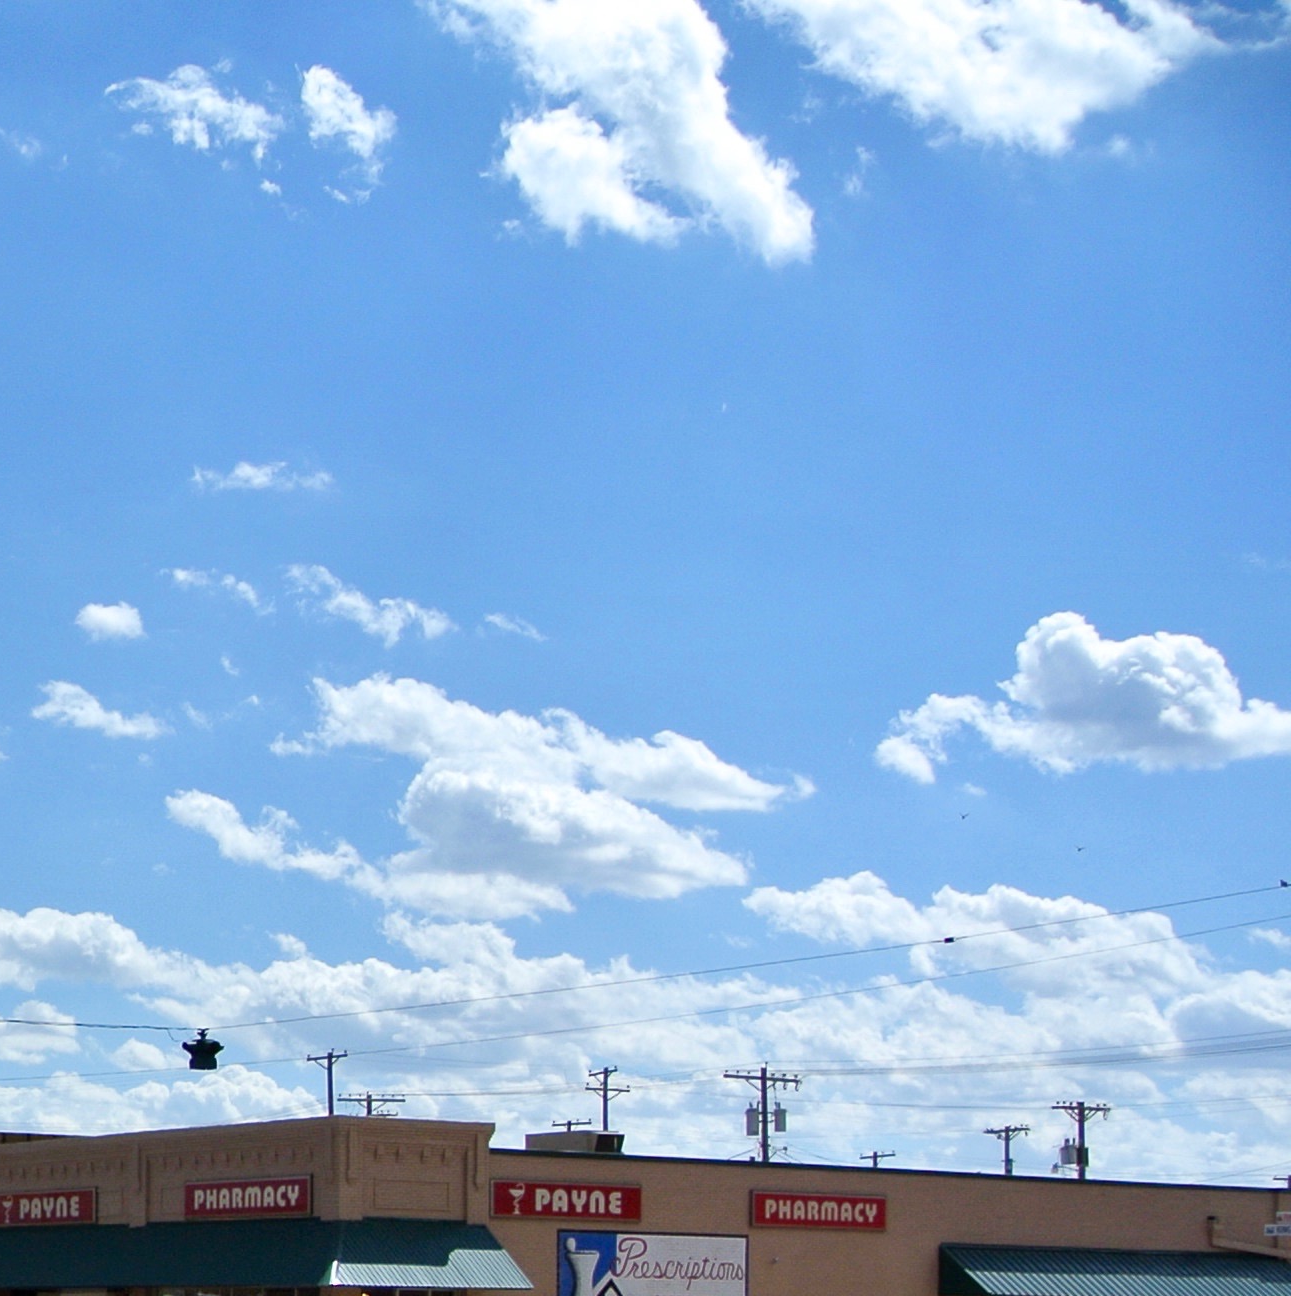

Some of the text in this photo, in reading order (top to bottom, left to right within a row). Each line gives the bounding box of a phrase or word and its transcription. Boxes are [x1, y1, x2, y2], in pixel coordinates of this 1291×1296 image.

[19, 1185, 299, 1219] PAYNE PHARMACY
[535, 1188, 877, 1223] PAYNE PHARMACY
[610, 1237, 744, 1290] Prescriptions
